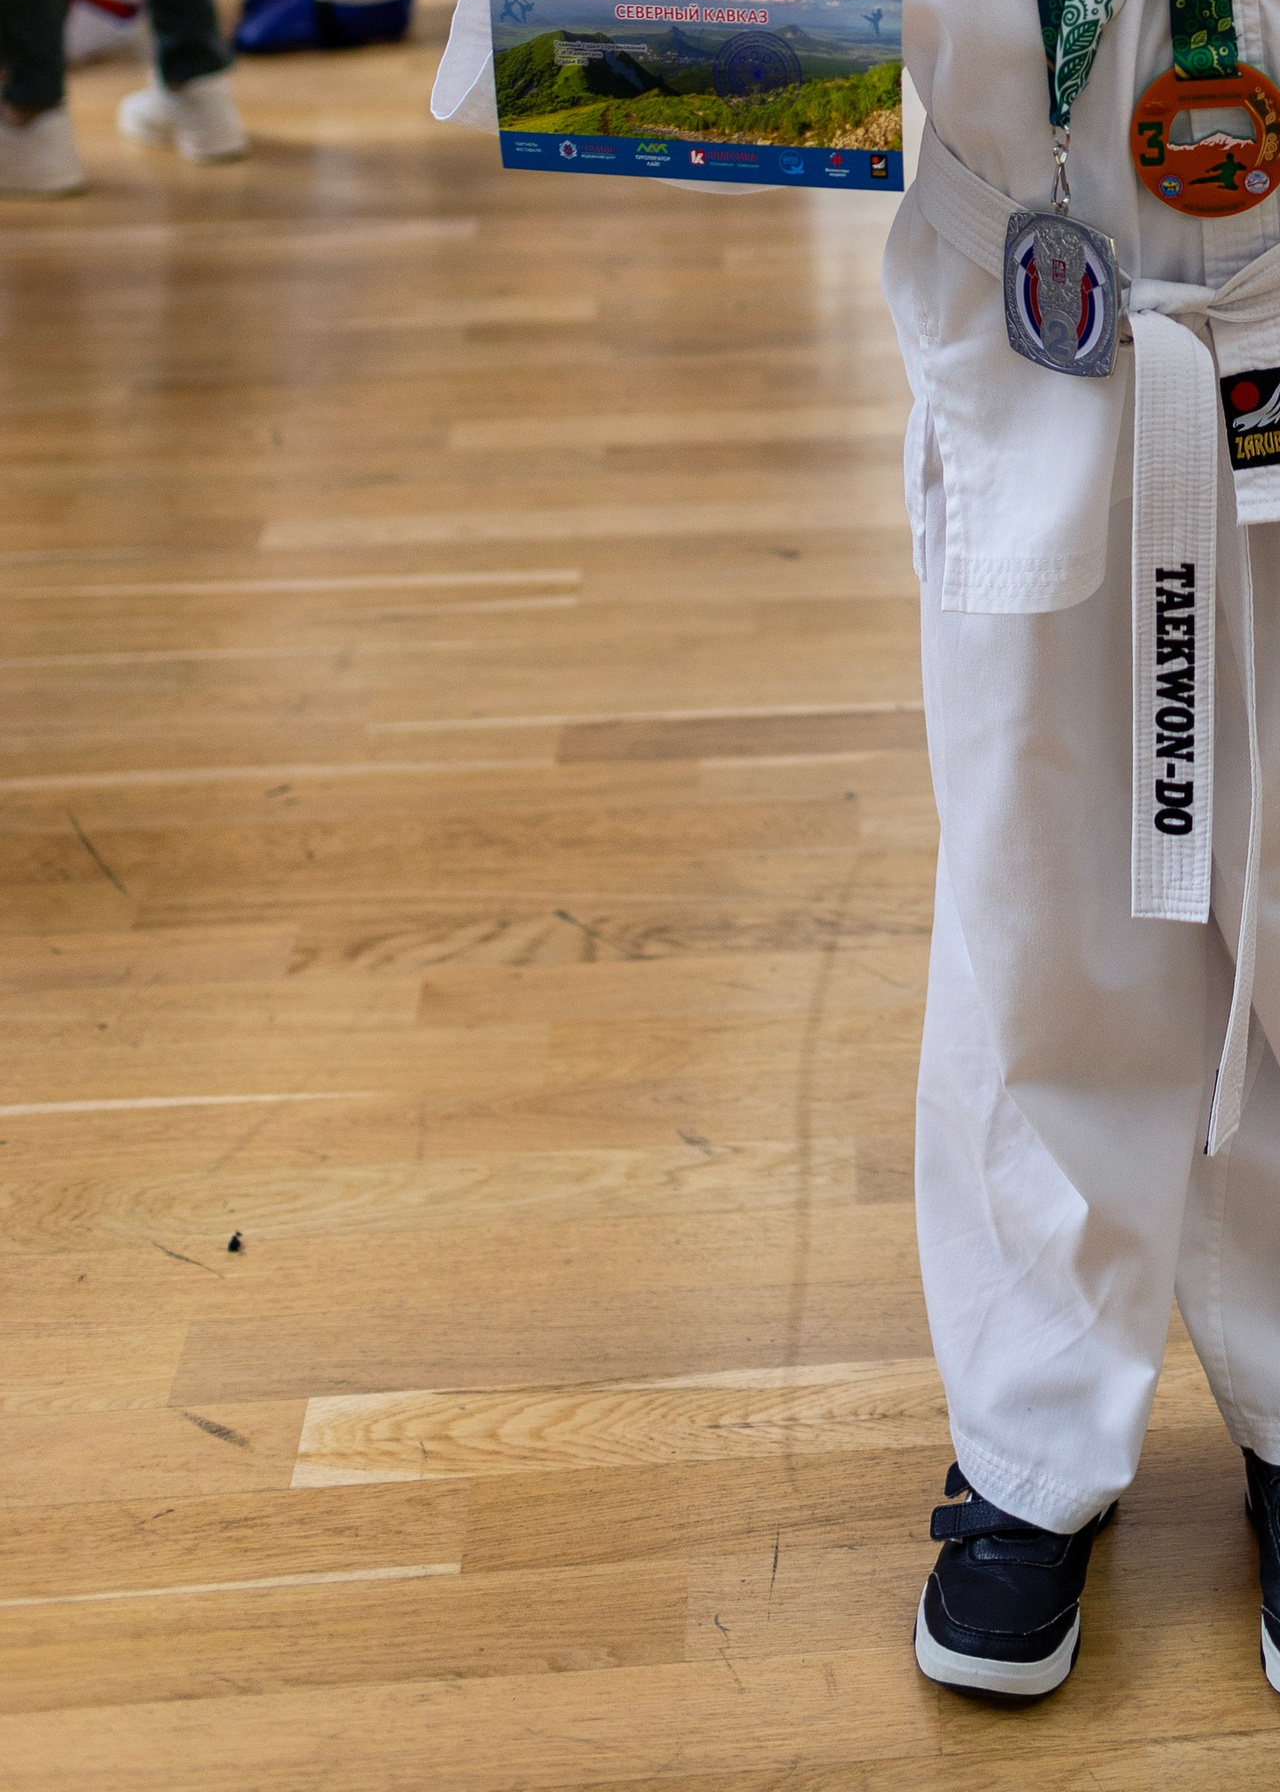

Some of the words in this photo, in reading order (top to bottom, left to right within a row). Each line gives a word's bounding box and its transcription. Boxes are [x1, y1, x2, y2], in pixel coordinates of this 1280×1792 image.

[615, 4, 700, 21] СЕВЕРНЫЙ
[704, 8, 768, 24] КАВКАЗ
[1138, 121, 1165, 167] 3
[1049, 320, 1069, 355] 2
[1154, 563, 1195, 836] TAEKWON-DO
